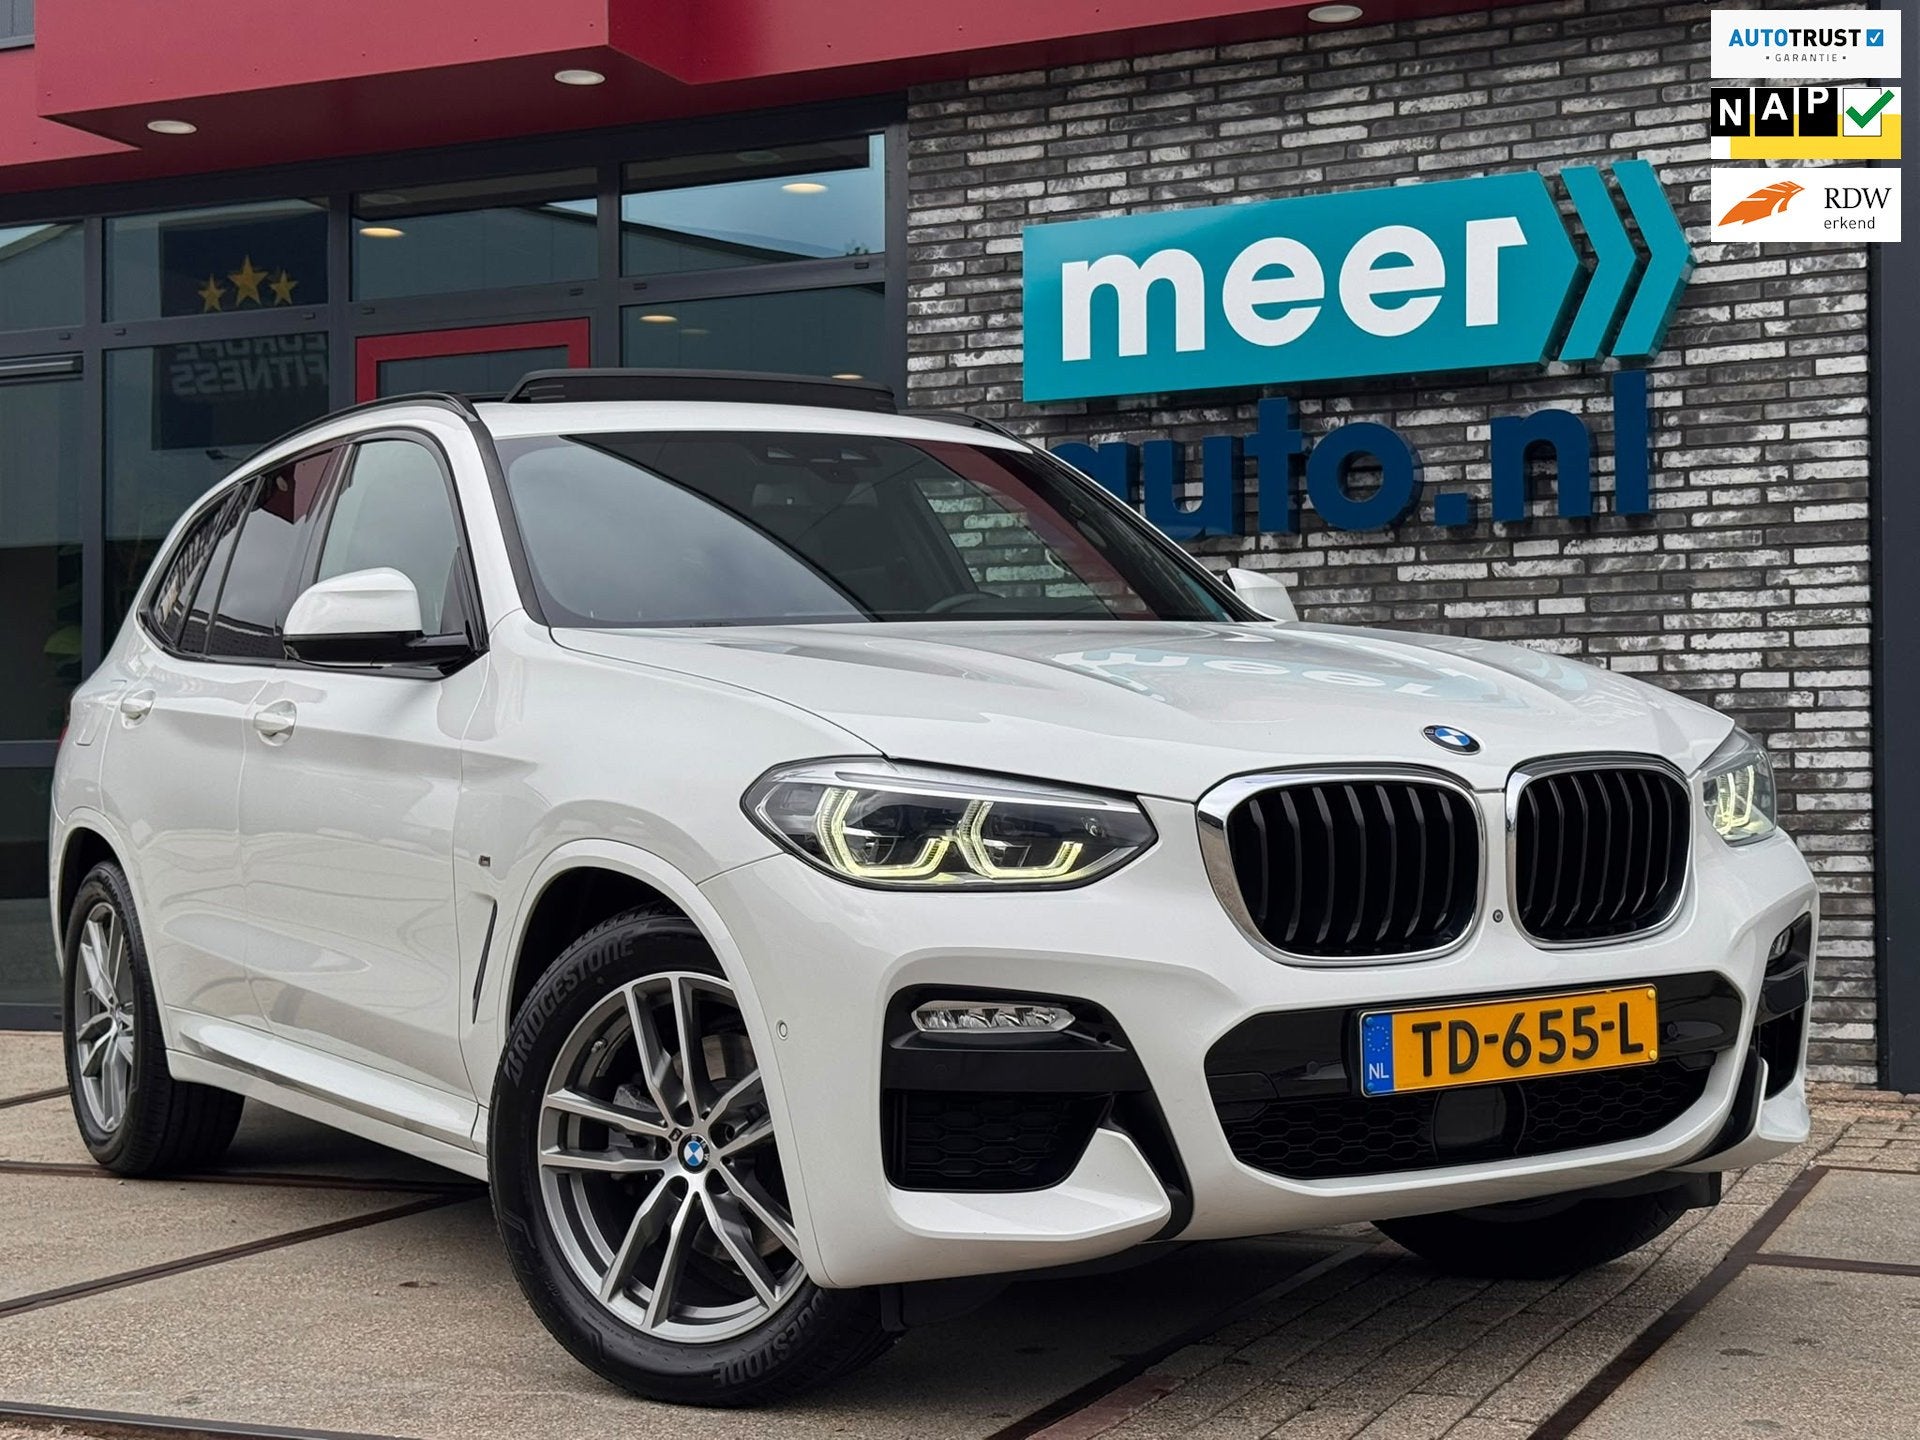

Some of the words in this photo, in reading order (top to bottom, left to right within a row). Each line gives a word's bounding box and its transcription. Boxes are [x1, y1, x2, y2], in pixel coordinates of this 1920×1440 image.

[1061, 216, 1528, 362] meer
[502, 929, 635, 1088] BRIDGESTONE
[1411, 1001, 1644, 1077] TD-655-L
[1368, 1063, 1389, 1081] NL
